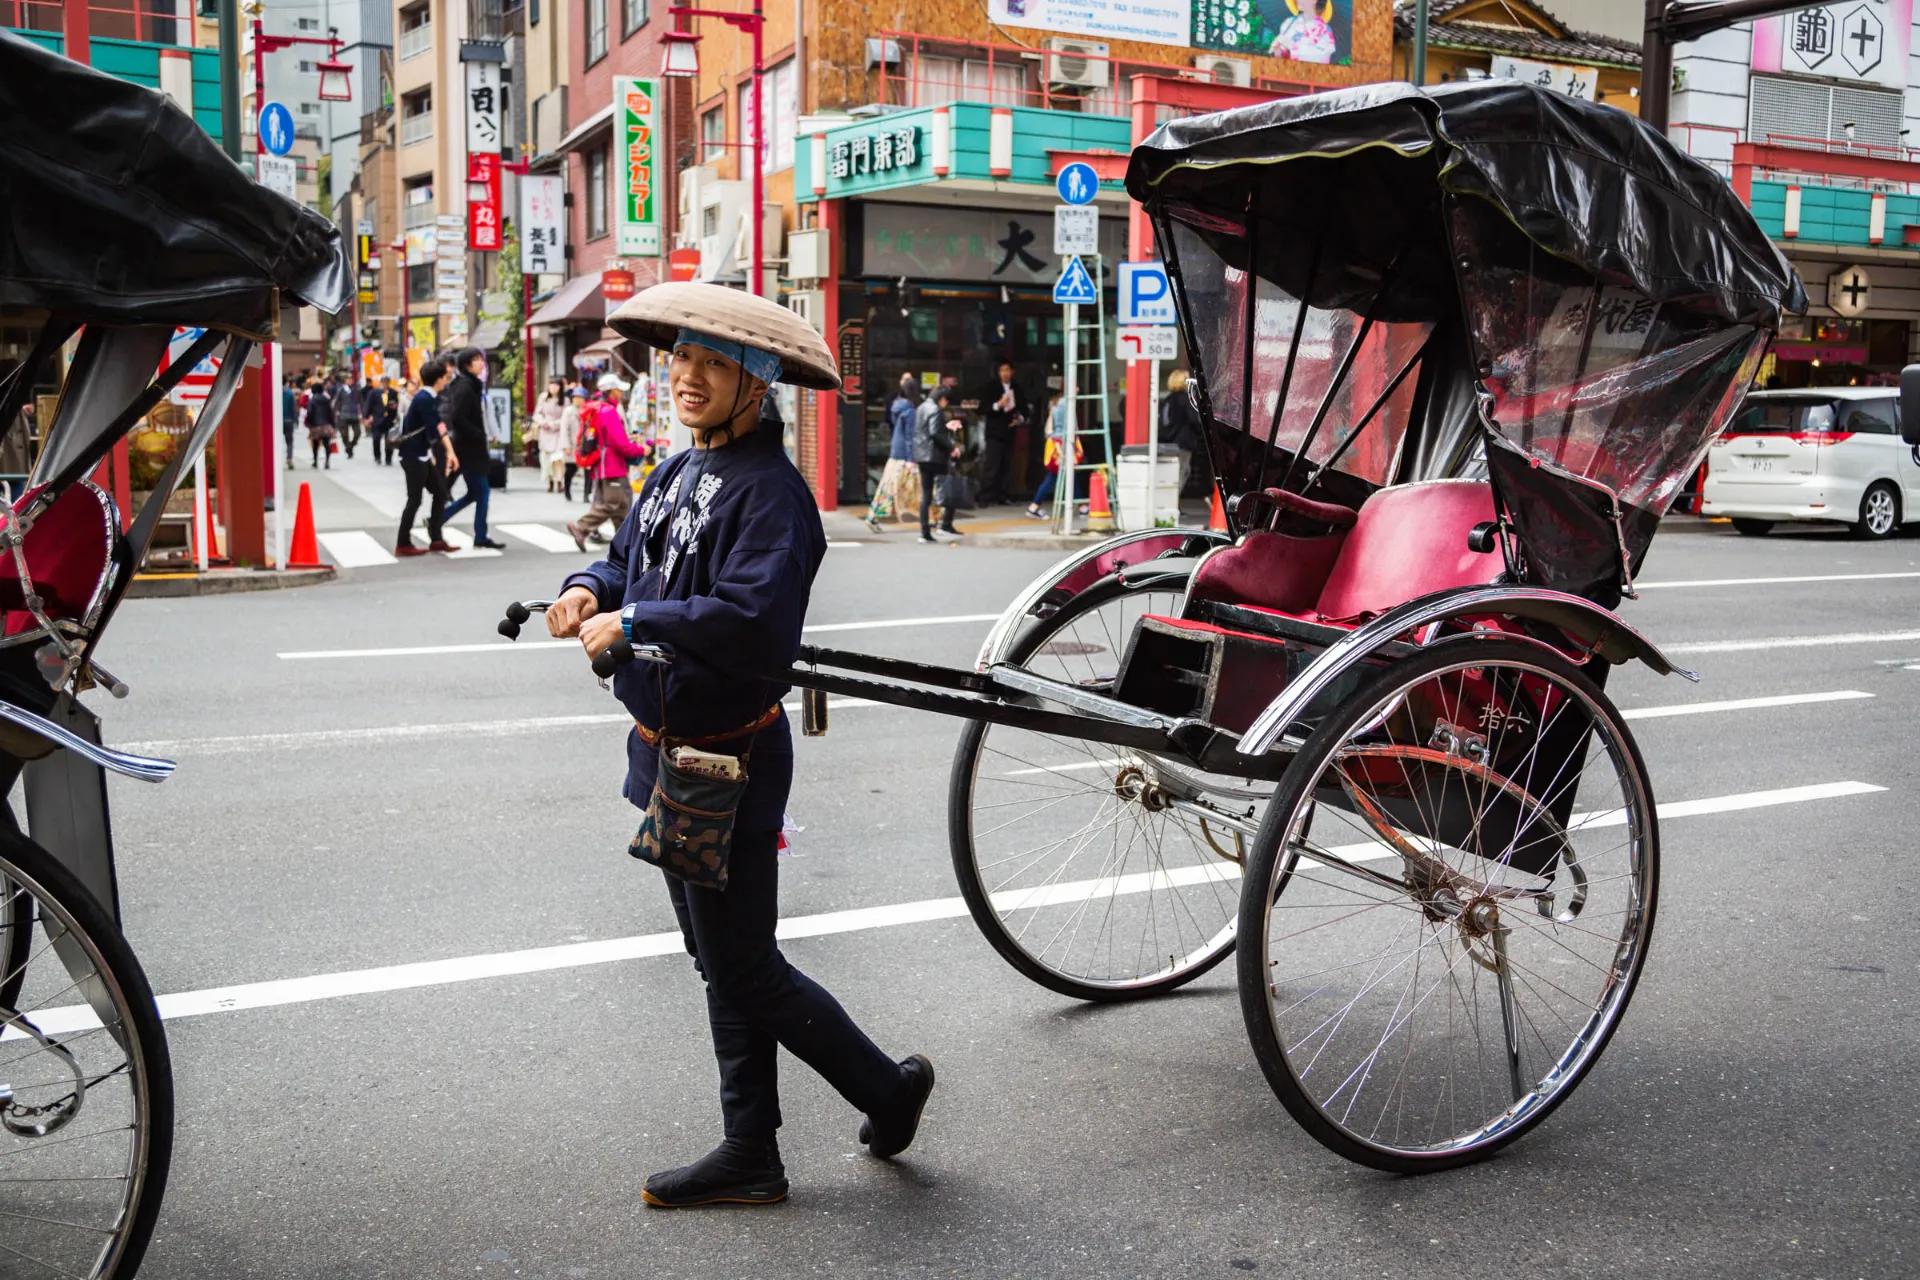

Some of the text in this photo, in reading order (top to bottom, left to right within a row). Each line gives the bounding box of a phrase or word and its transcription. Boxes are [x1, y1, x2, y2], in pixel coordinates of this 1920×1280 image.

[628, 125, 651, 220] フジカラー
[832, 126, 916, 179] 雷門東部
[1131, 270, 1168, 317] P
[1478, 702, 1531, 734] 拾六
